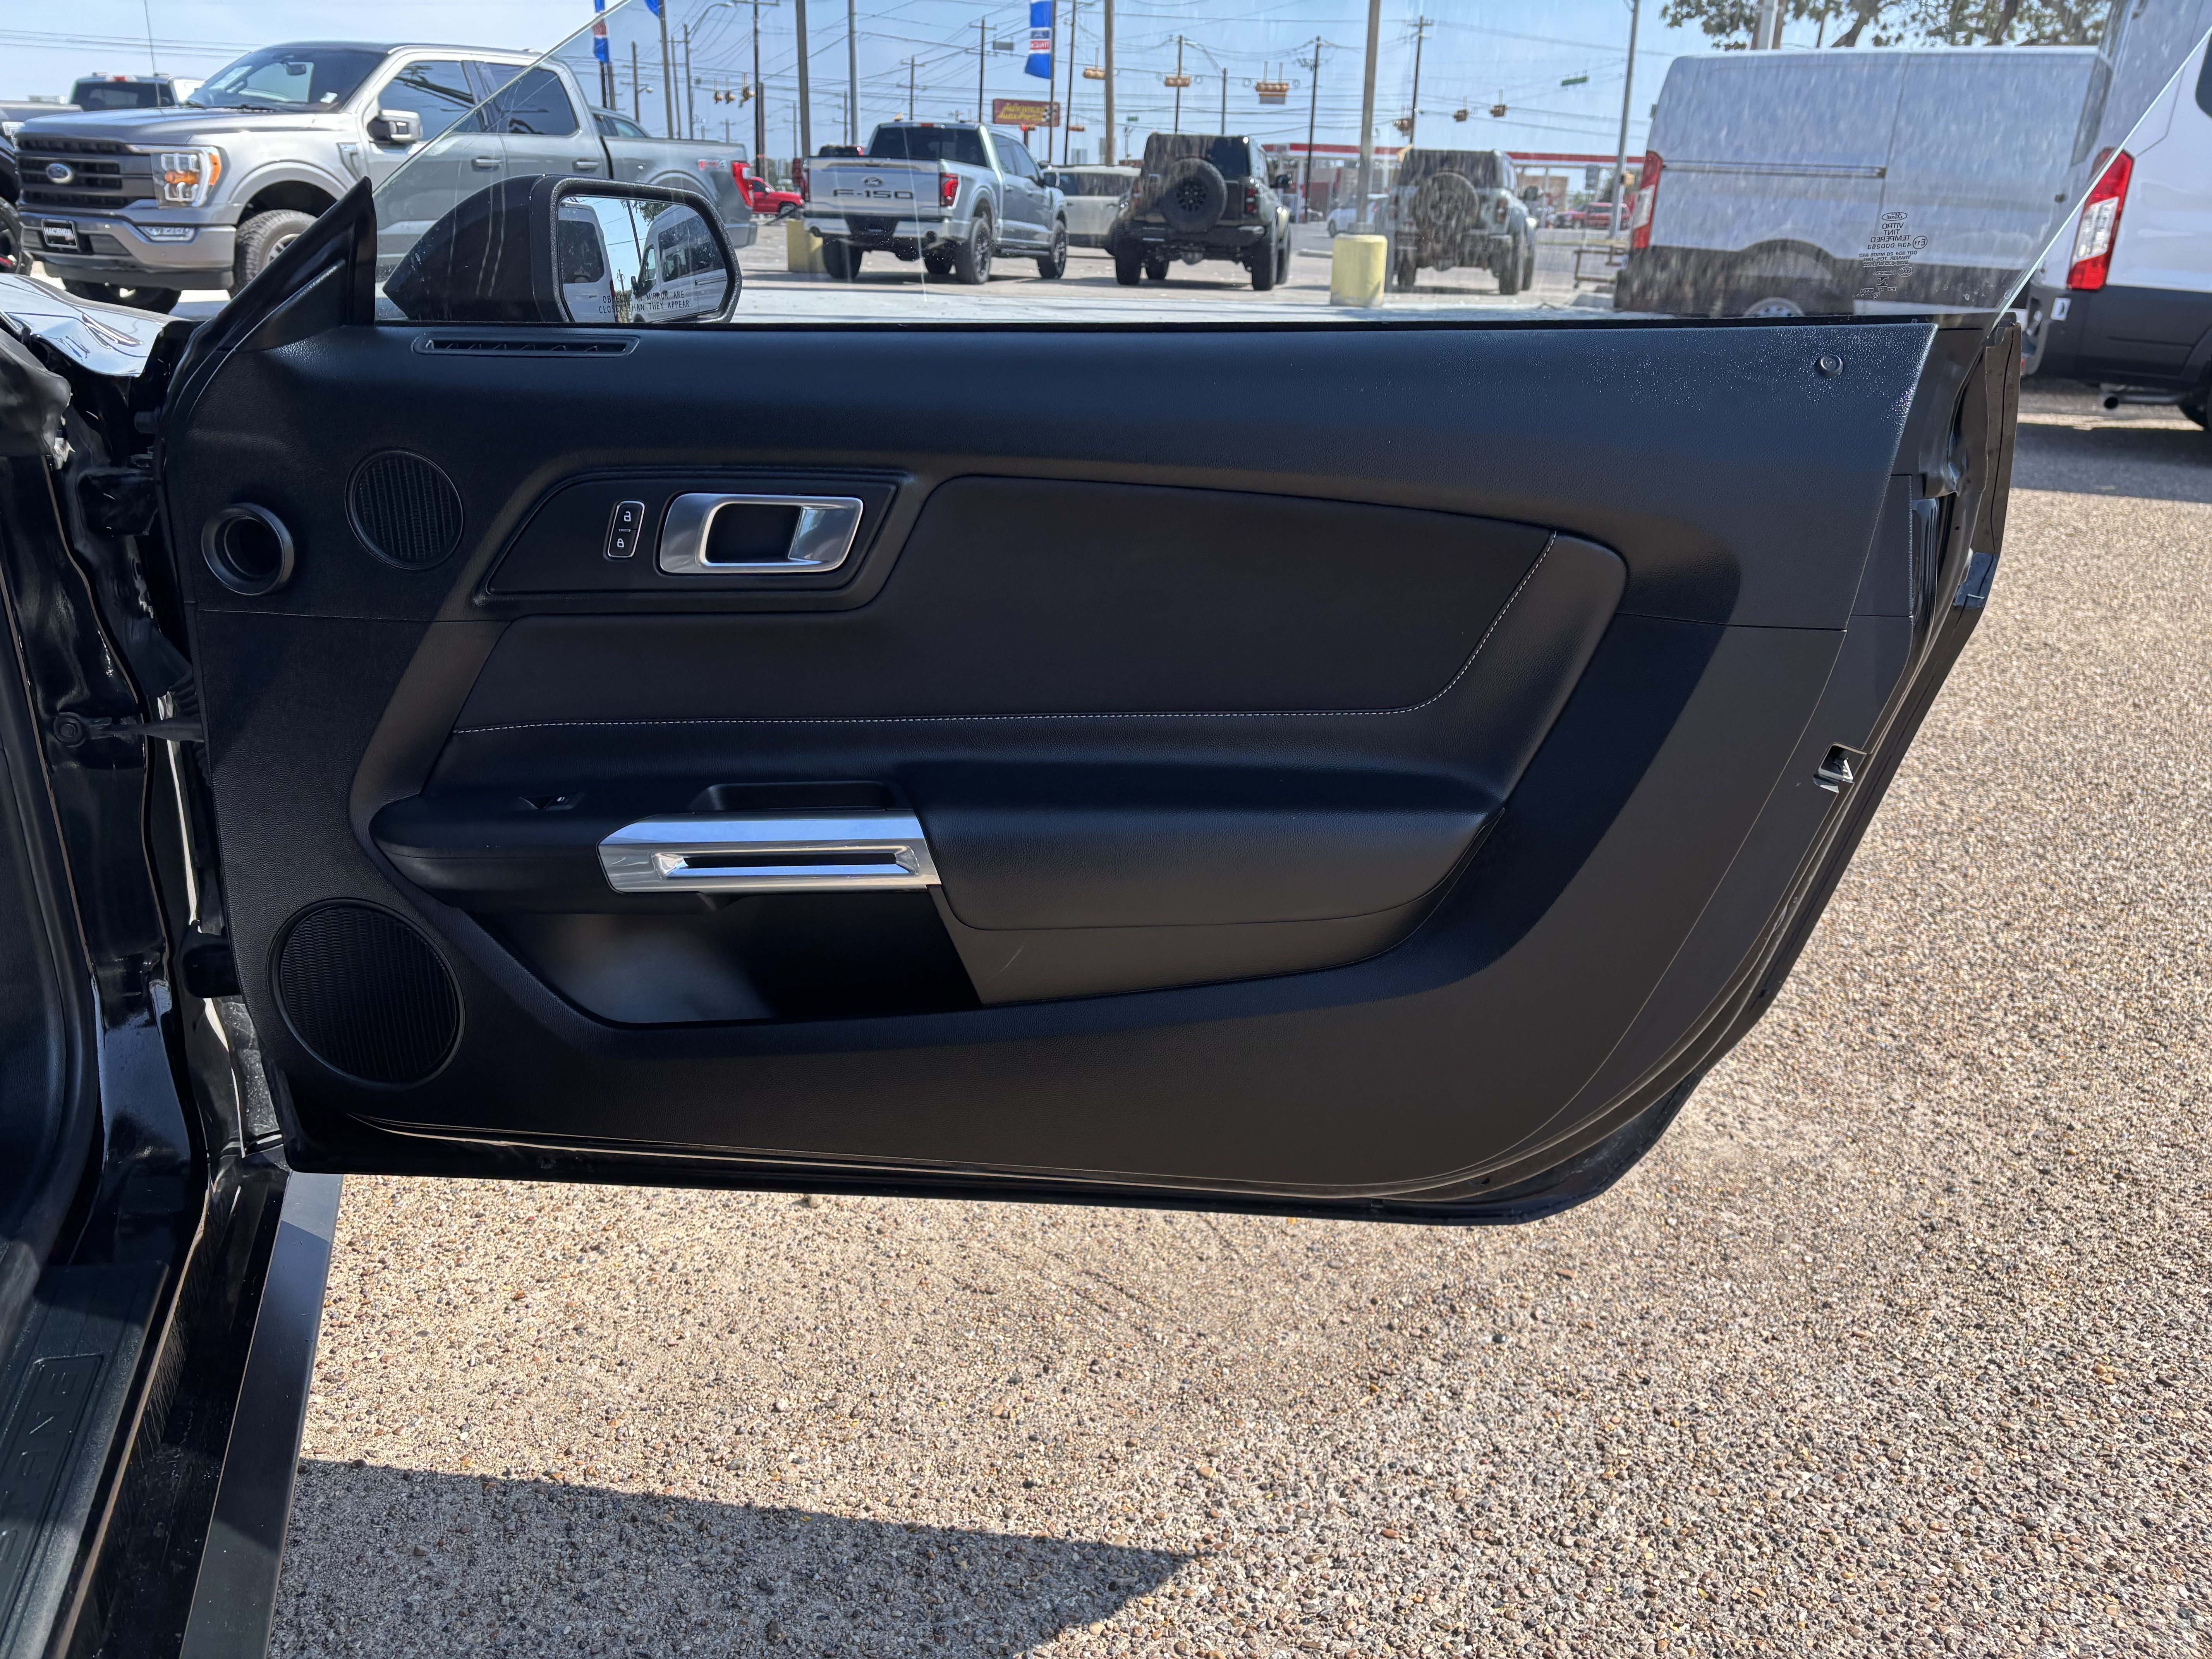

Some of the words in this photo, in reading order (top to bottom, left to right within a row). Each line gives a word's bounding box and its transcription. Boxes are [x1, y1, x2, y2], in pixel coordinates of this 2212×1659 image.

[833, 189, 913, 199] F-150
[646, 290, 669, 301] MIRROR
[627, 303, 644, 312] HAN
[649, 302, 663, 310] THEY
[668, 300, 689, 309] APPEAR
